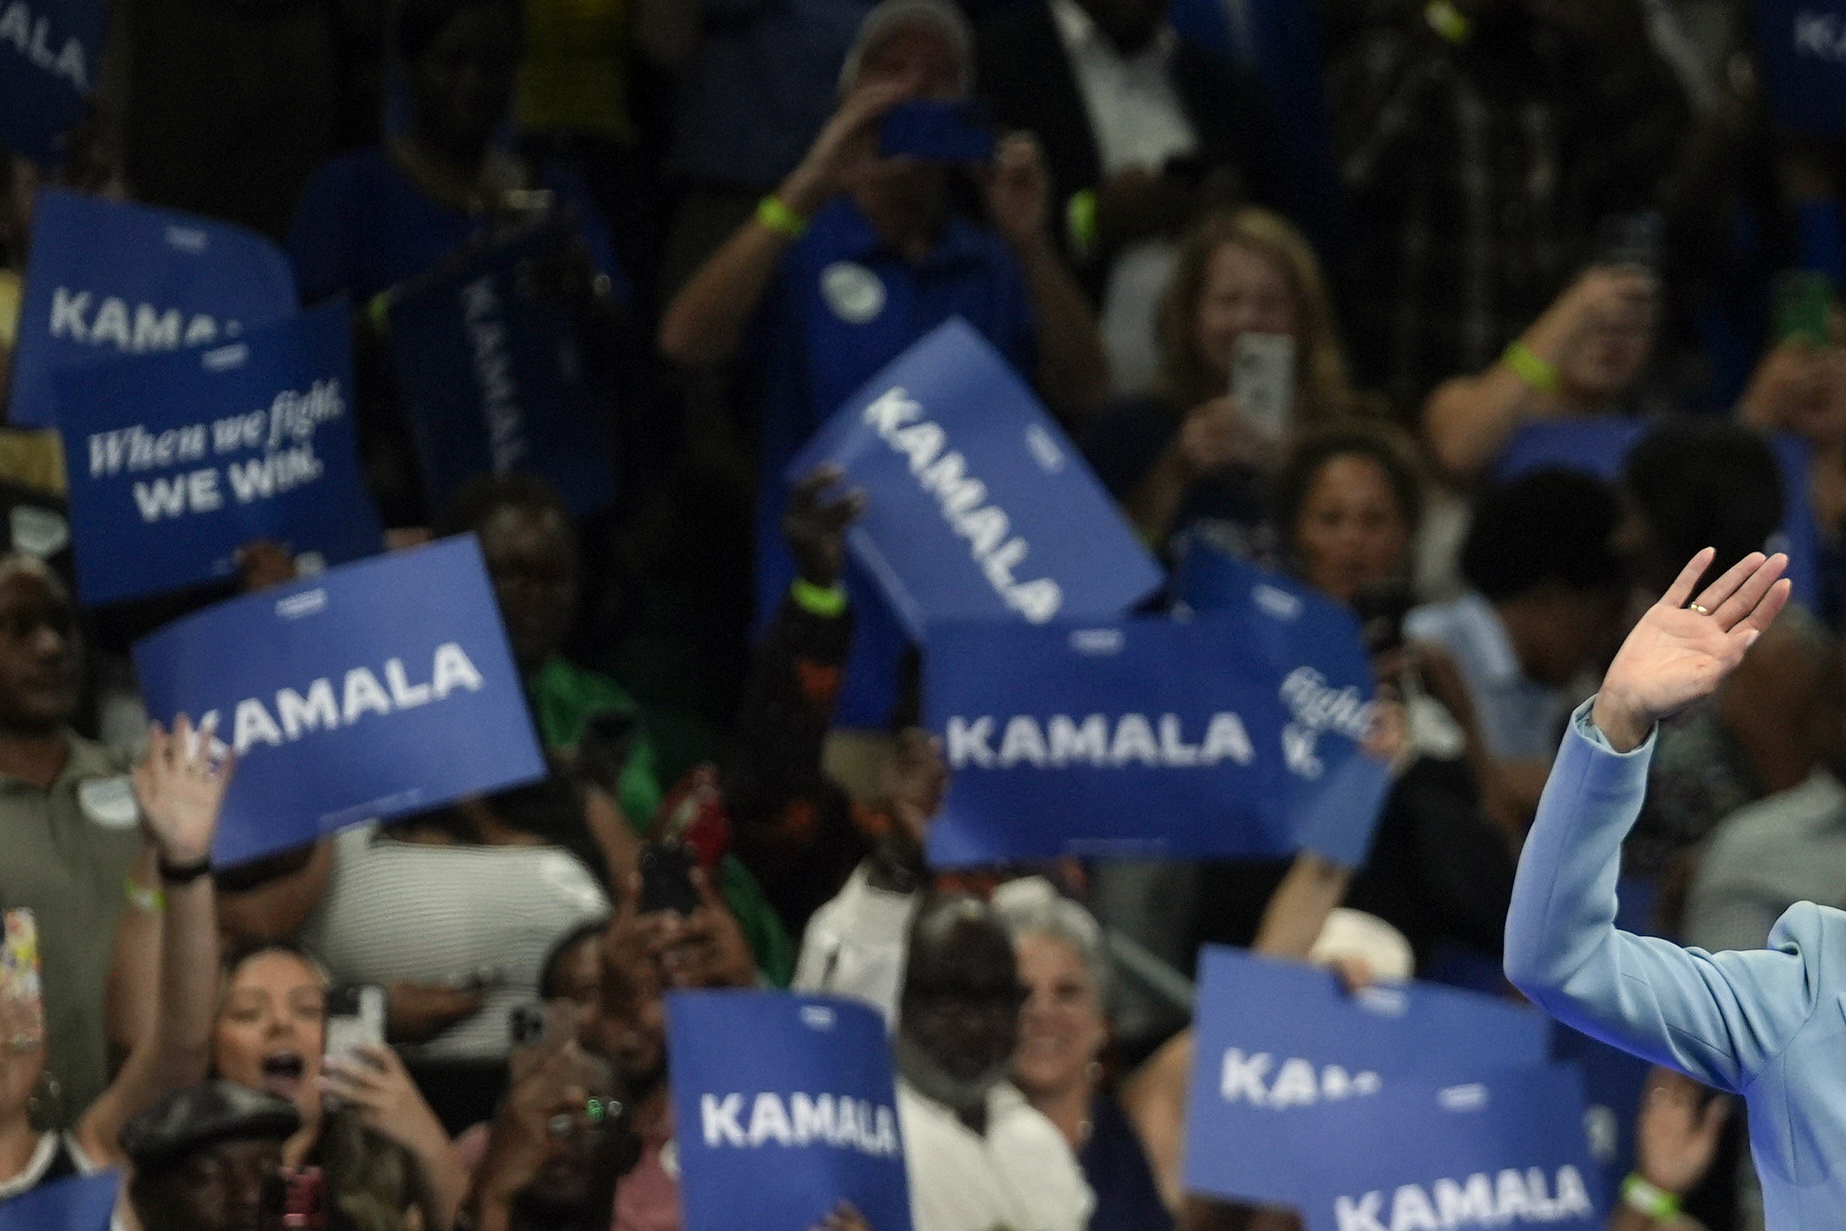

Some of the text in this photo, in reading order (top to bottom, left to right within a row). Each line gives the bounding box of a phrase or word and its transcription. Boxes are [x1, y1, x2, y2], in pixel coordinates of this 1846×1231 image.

[87, 423, 209, 480] When
[210, 409, 270, 456] we
[131, 467, 224, 523] WE
[862, 386, 1063, 625] KAMALA
[945, 710, 1257, 769] KAMALA
[702, 1091, 896, 1158] KAMALA
